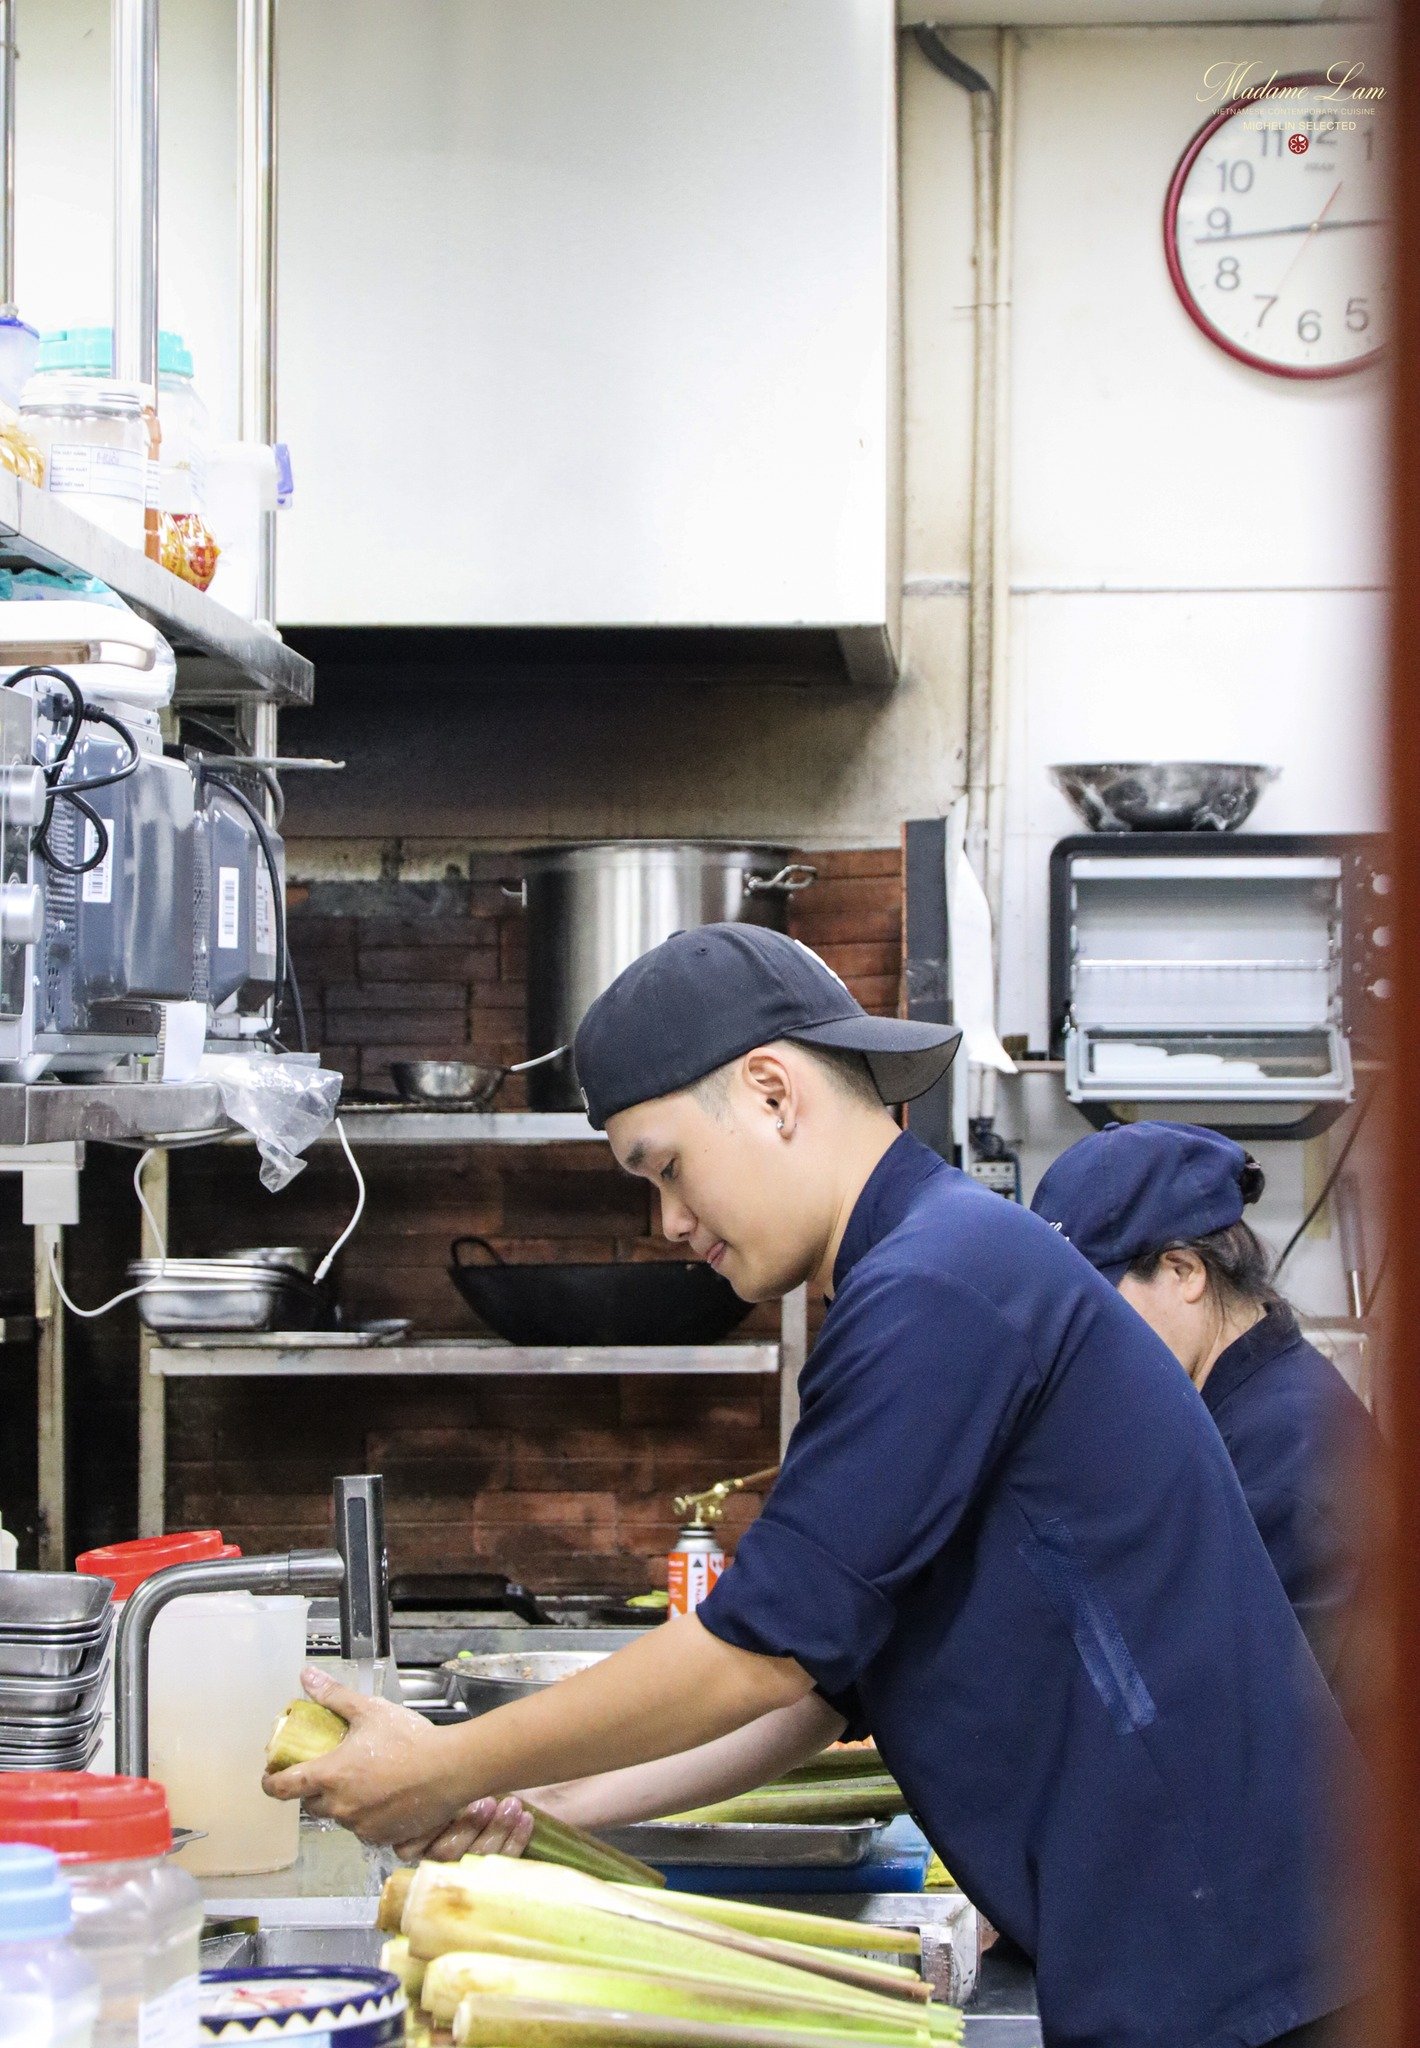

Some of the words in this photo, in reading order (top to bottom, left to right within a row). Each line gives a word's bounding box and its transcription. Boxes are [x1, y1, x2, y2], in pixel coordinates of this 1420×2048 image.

[1216, 159, 1254, 193] 10
[1206, 206, 1231, 238] 9
[1215, 256, 1241, 292] 8
[1253, 294, 1279, 328] 7
[1296, 309, 1322, 343] 6
[1344, 298, 1369, 332] 5
